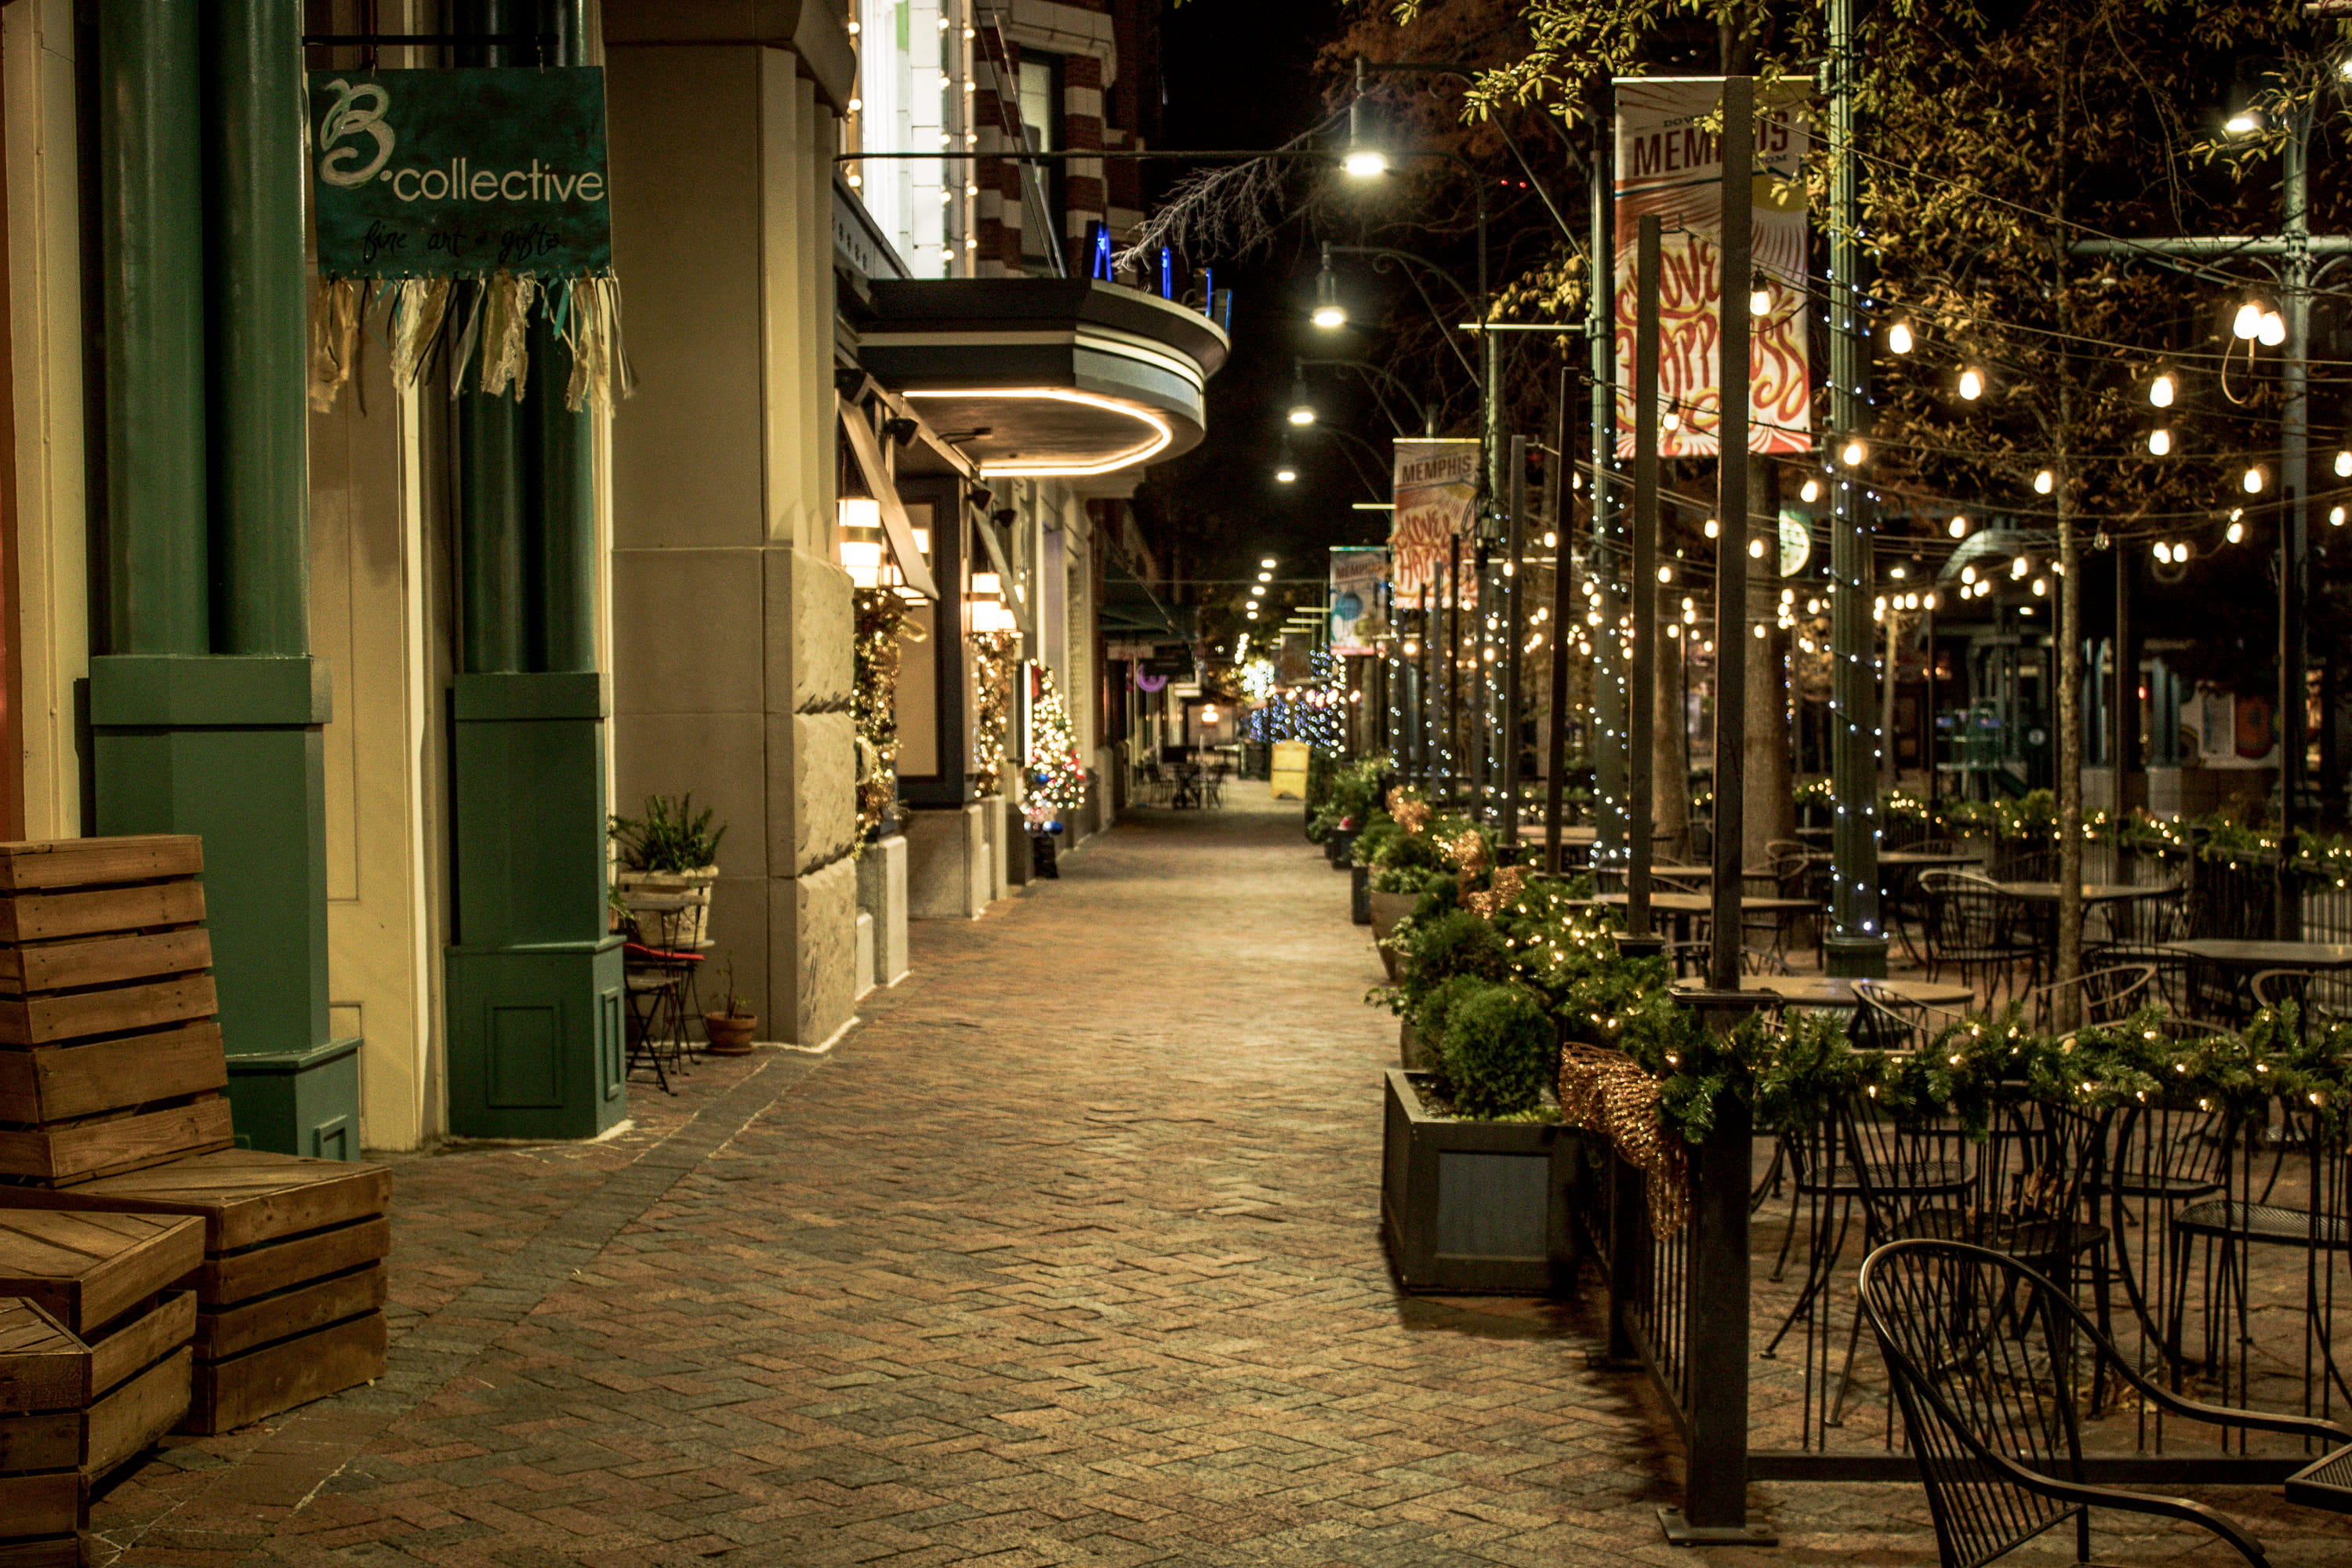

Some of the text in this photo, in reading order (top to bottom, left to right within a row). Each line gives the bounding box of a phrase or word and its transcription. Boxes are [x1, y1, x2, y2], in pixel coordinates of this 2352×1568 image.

[1633, 112, 1788, 176] MEMIS
[362, 220, 407, 263] fine
[427, 227, 466, 257] art
[499, 222, 566, 264] gifts
[1402, 455, 1472, 483] MEMPHIS
